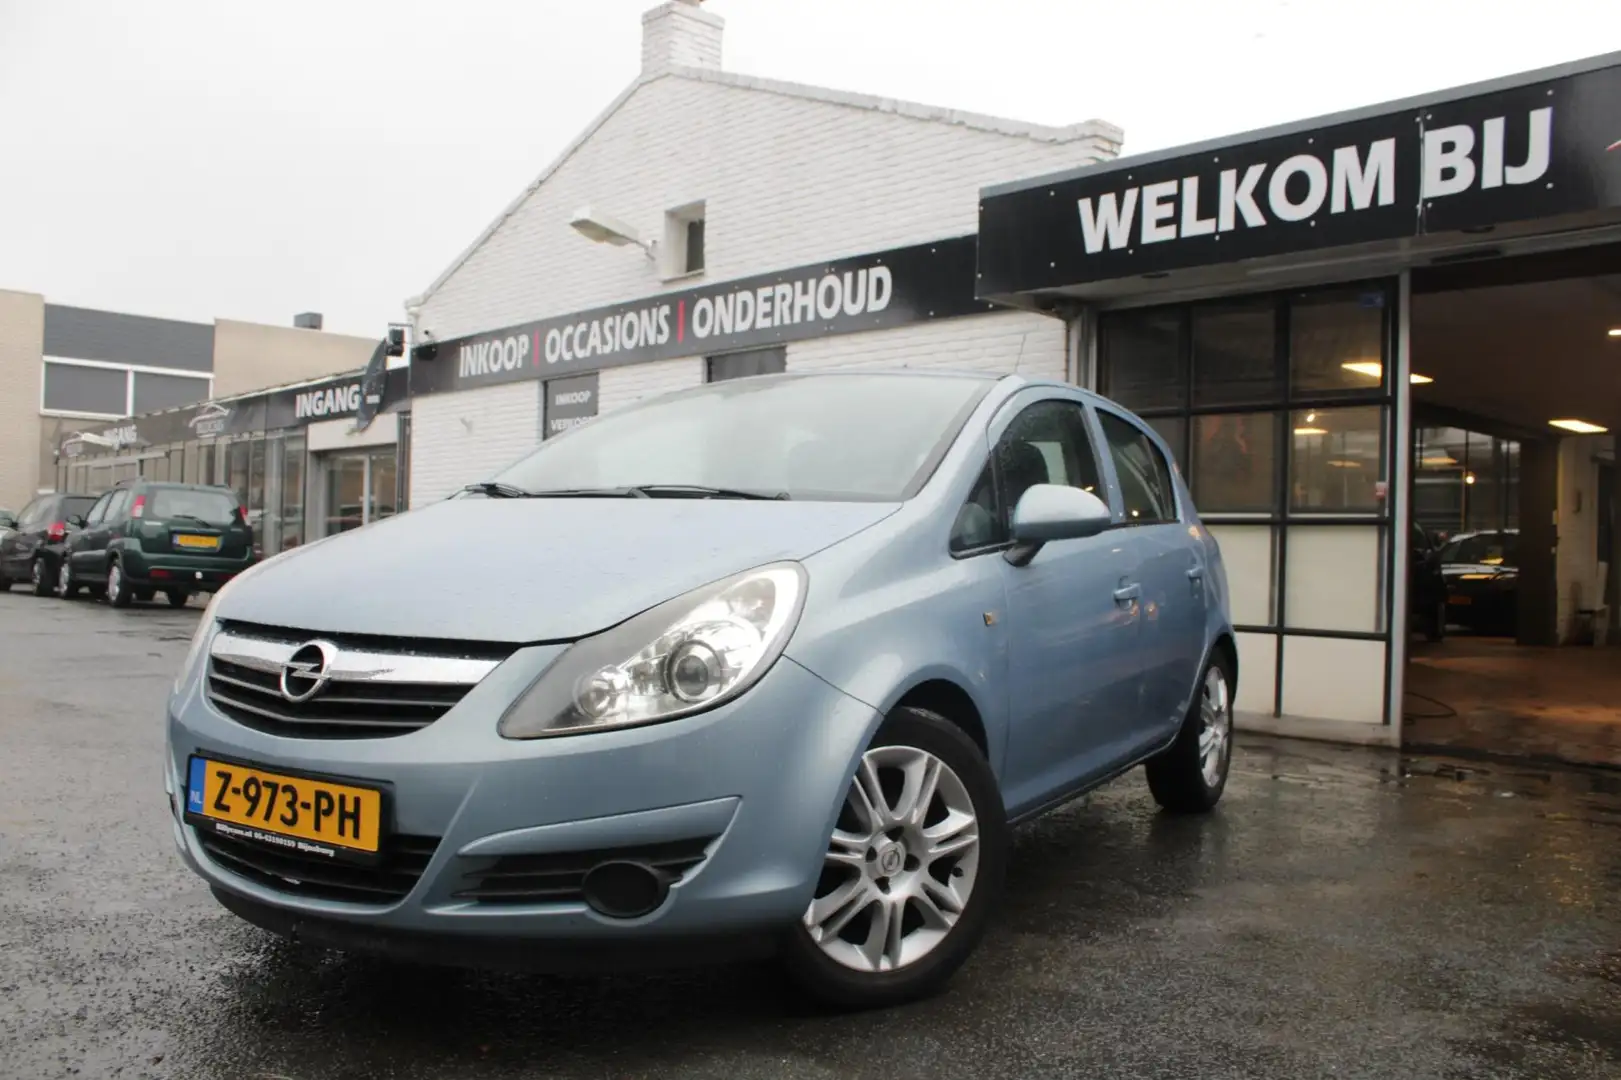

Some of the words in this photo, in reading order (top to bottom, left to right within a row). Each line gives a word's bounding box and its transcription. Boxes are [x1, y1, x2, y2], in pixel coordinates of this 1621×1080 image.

[1078, 137, 1396, 254] WELKOM
[1422, 107, 1552, 199] BIJ
[459, 334, 529, 377] INKOOP
[545, 304, 671, 363] OCCASIONS
[692, 265, 892, 338] ONDERHOUD
[295, 383, 361, 418] INGANG
[214, 770, 361, 840] Z-973-PH
